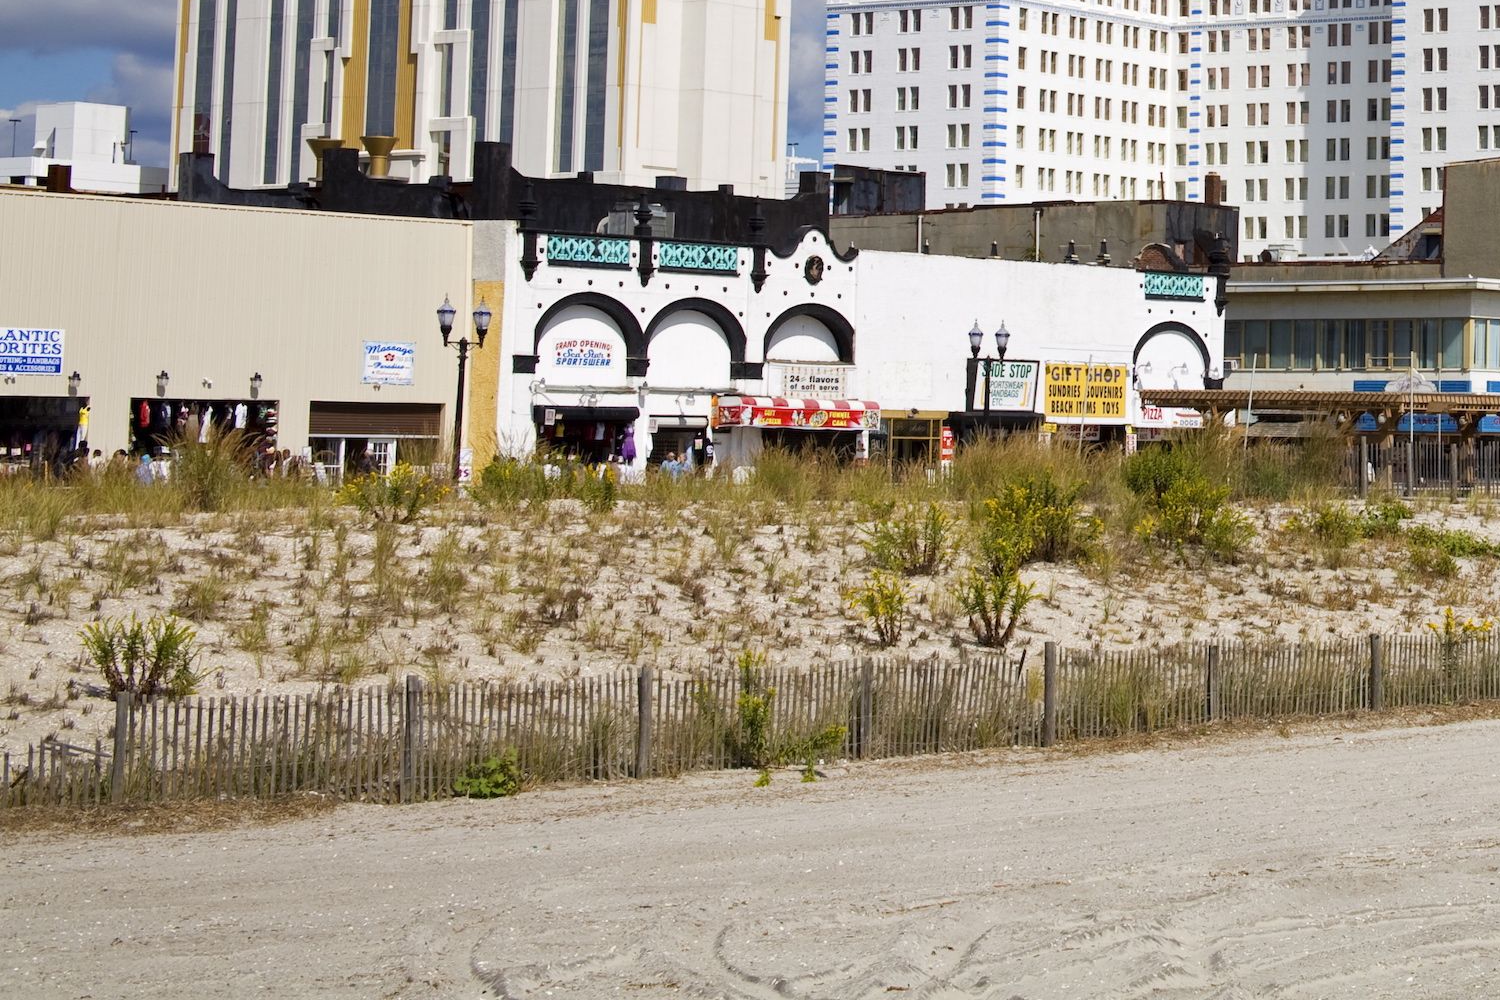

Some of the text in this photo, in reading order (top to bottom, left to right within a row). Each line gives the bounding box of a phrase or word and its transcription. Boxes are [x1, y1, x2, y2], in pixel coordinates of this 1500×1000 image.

[365, 344, 415, 356] Massage
[555, 341, 577, 350] GRAND
[556, 358, 611, 366] SPORTSWEAR
[1009, 364, 1032, 379] STOP
[1051, 367, 1083, 381] GIFT
[809, 375, 840, 384] flavors
[990, 380, 1024, 389] PORTSWEAR
[1049, 385, 1123, 399] SUNDRIES SOUVENIRS
[1051, 401, 1120, 415] BEACH ITMS TOYS
[1143, 408, 1163, 420] PIZZA
